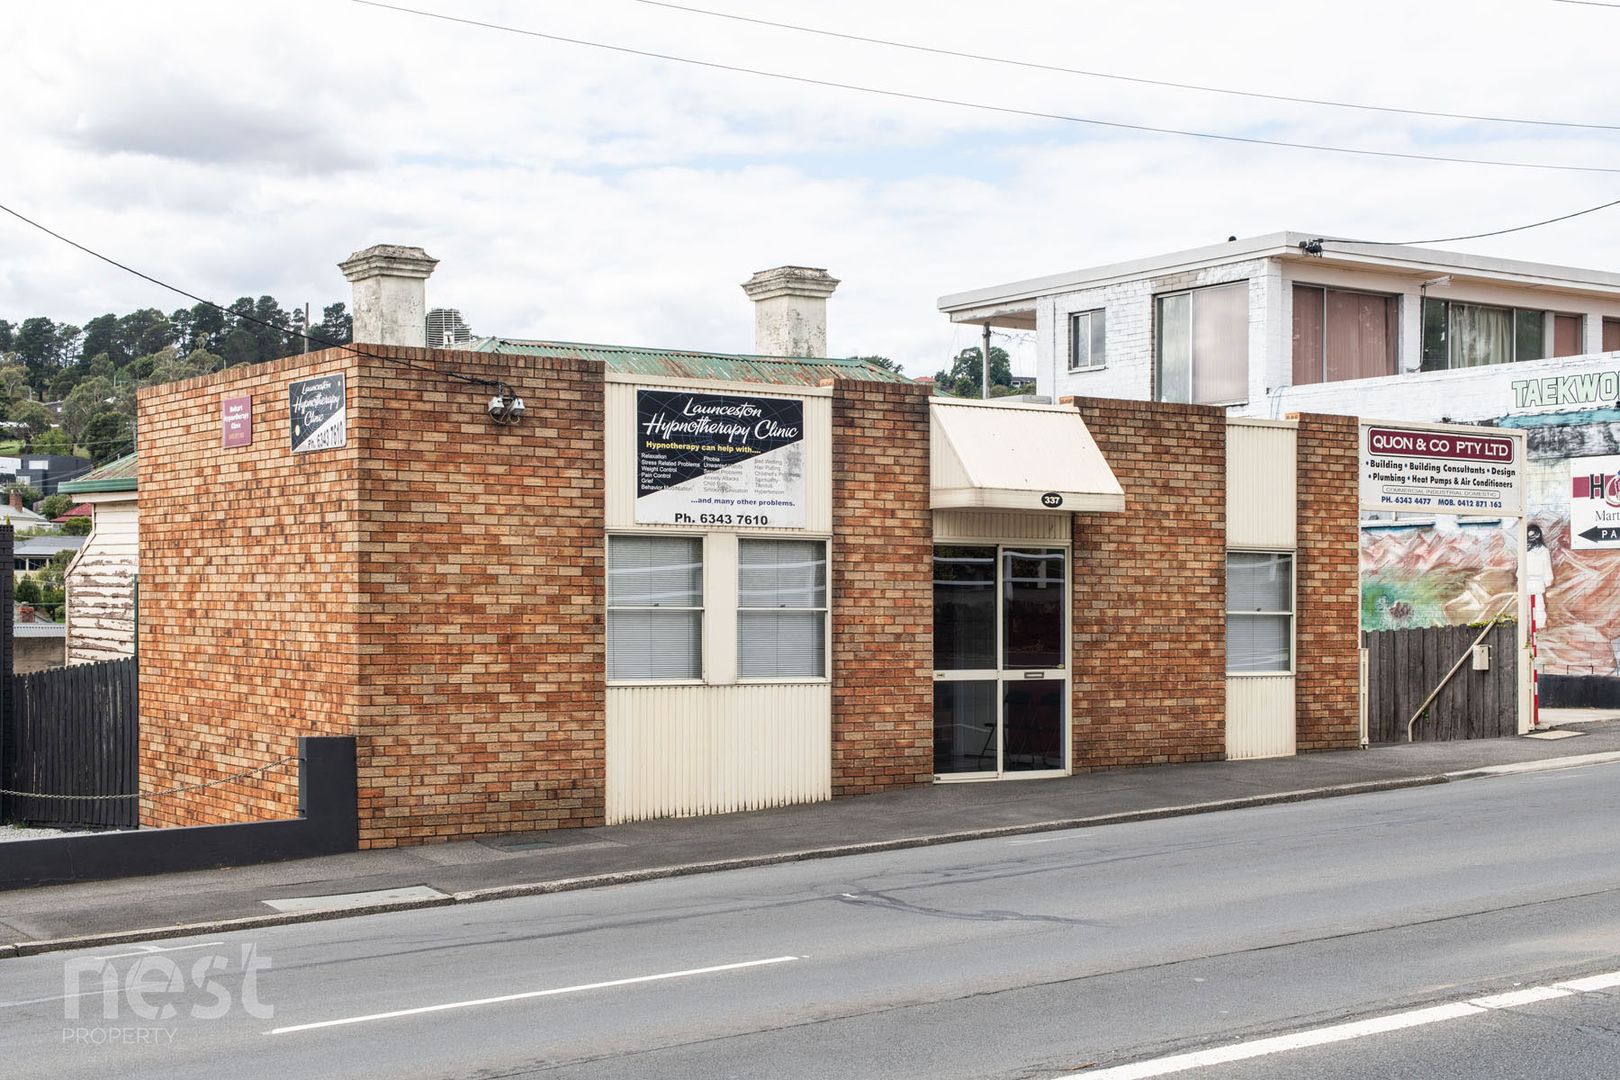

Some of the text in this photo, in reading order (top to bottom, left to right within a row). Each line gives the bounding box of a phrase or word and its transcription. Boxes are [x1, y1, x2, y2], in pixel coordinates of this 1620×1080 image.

[1512, 371, 1620, 408] TAEKWO
[293, 393, 340, 414] Hypnotherapy
[683, 397, 762, 418] Launceston
[304, 411, 324, 426] Clinic
[642, 412, 799, 444] Hypnotherapy Clinic
[646, 441, 700, 452] Hypnotherapy
[717, 444, 734, 453] help
[1373, 434, 1509, 456] QUON & CO PTY LTD
[1371, 460, 1515, 477] Building Building Consultants Design
[1373, 473, 1405, 484] Plumbing
[1412, 475, 1428, 483] Heat
[1430, 476, 1452, 486] Pumps
[1461, 478, 1470, 486] Air
[1473, 479, 1512, 488] Conditioners
[714, 499, 734, 507] many
[758, 499, 795, 508] problems.
[674, 513, 768, 525] Ph. 6343 7610
[1596, 510, 1620, 521] Mart
